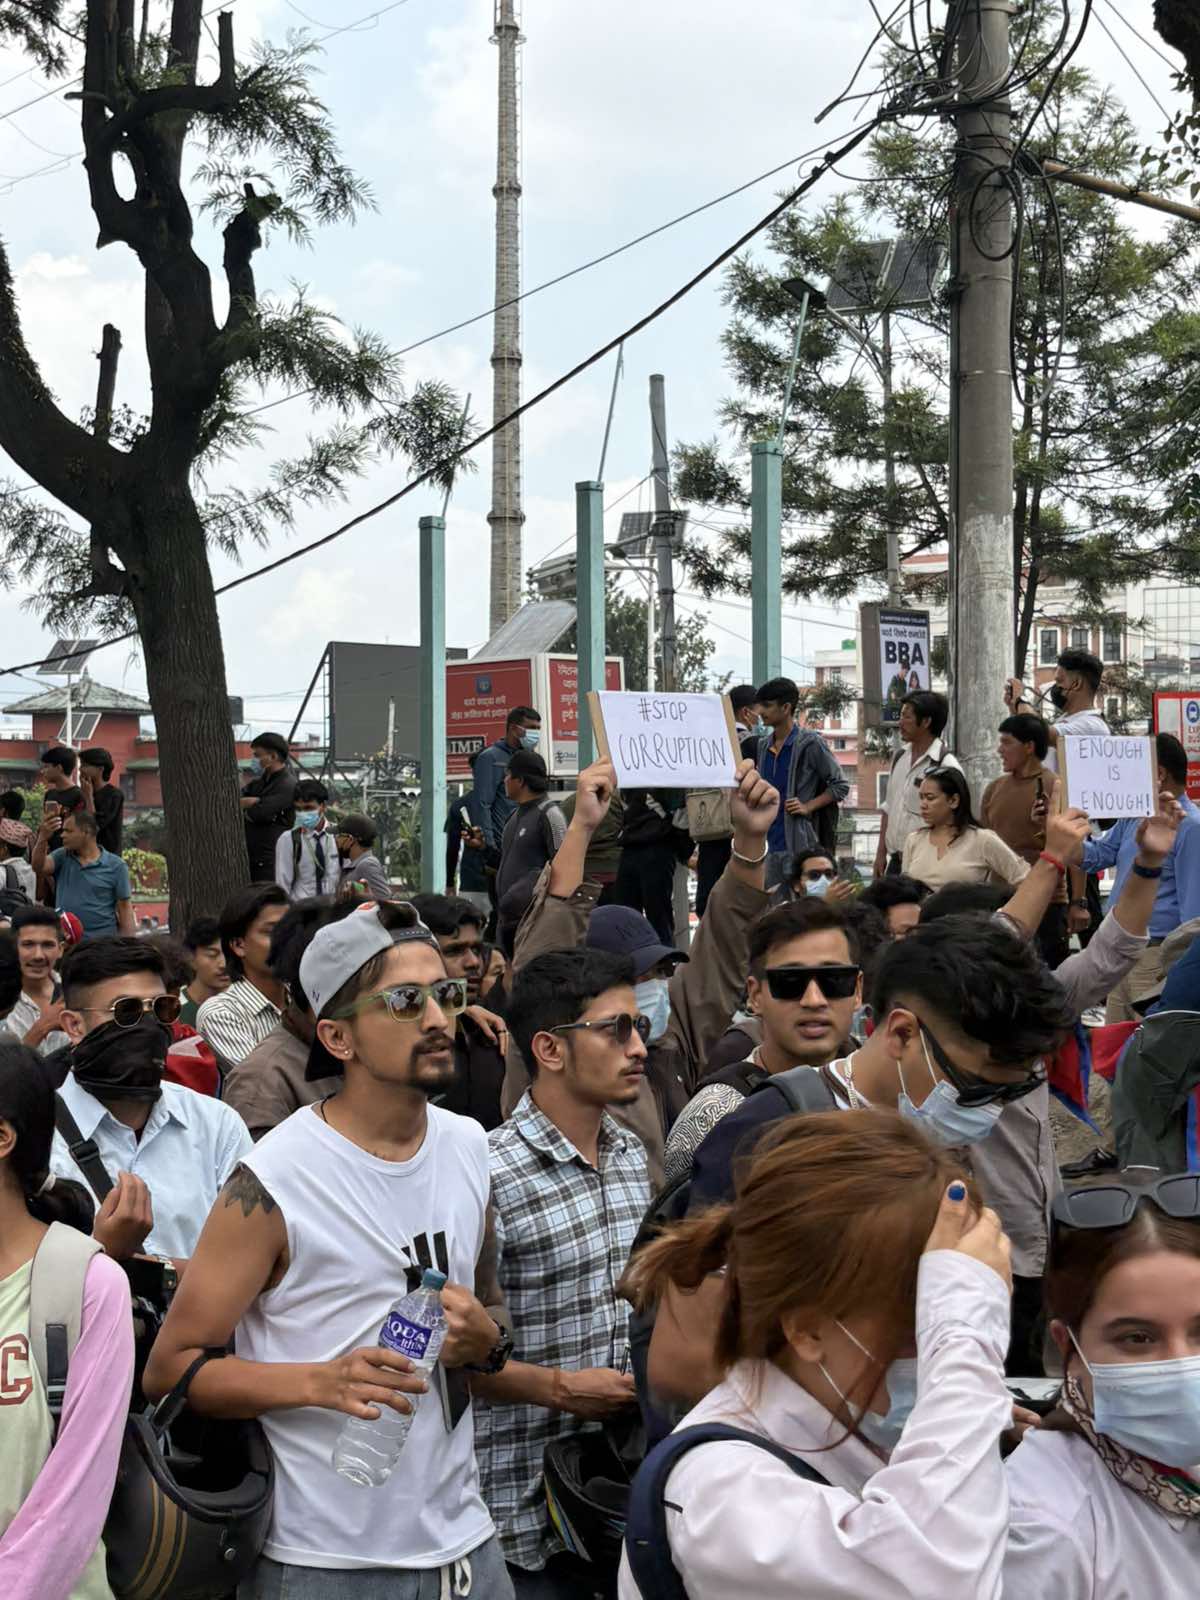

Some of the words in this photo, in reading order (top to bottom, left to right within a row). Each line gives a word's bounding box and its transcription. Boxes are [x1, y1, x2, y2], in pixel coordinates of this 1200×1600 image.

[885, 641, 925, 666] BBA
[638, 697, 688, 722] #STOP
[618, 732, 726, 771] CORRUPTION
[1079, 738, 1143, 760] ENOUGH
[1107, 765, 1121, 781] IS
[1081, 791, 1151, 816] ENOUGH!
